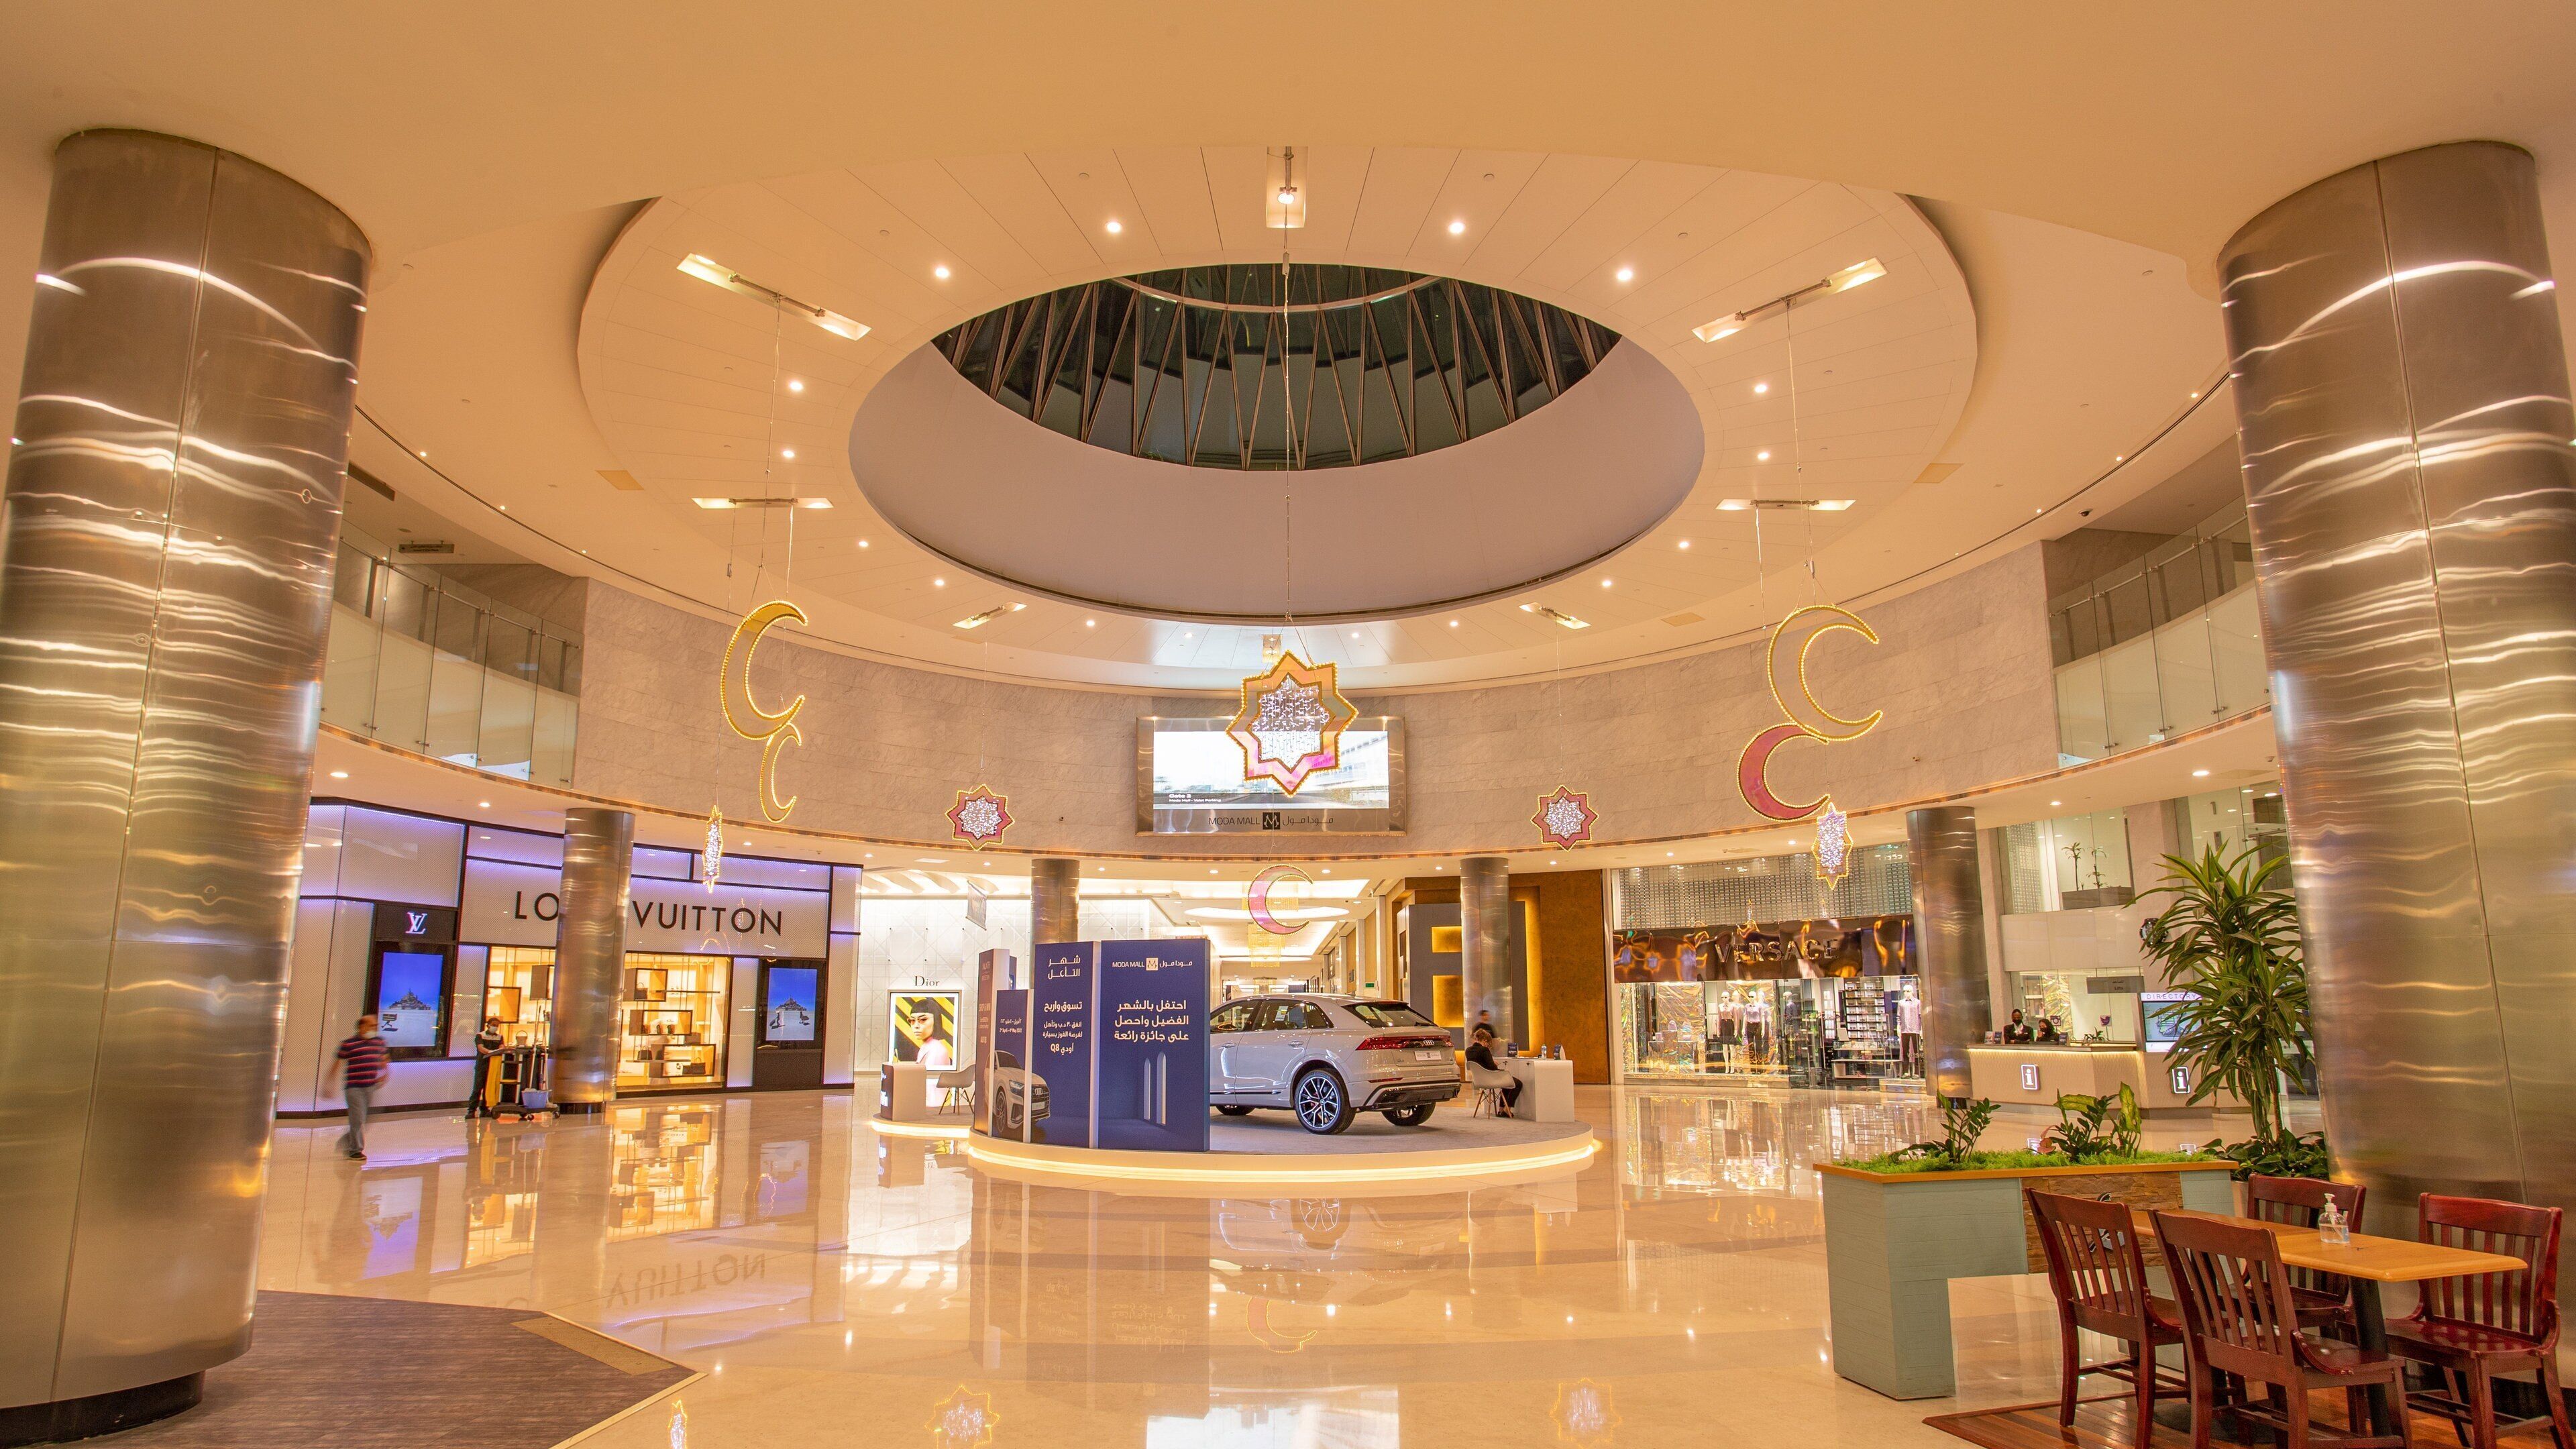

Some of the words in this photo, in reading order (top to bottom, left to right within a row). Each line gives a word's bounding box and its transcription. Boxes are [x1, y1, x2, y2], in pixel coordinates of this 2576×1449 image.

[1208, 817, 1235, 825] MODA
[1237, 817, 1260, 825] MALL
[1282, 816, 1305, 826] مول
[1307, 816, 1334, 826] مودا
[632, 900, 782, 936] VUITTON
[1714, 939, 1839, 963] VERSACE
[1159, 960, 1175, 968] مول
[1175, 960, 1193, 968] مودا
[914, 975, 940, 987] Dior
[1061, 1001, 1083, 1012] تسوق
[1117, 1000, 1154, 1012] بالشهر
[1156, 1000, 1186, 1012] احتفل
[1114, 1015, 1149, 1028] واحصل
[1151, 1015, 1189, 1028] الفضيل
[1114, 1030, 1138, 1042] رائعة
[1140, 1030, 1165, 1042] جائزة
[1167, 1030, 1189, 1043] على
[1050, 1043, 1060, 1053] Q8
[1061, 1042, 1074, 1056] أودي
